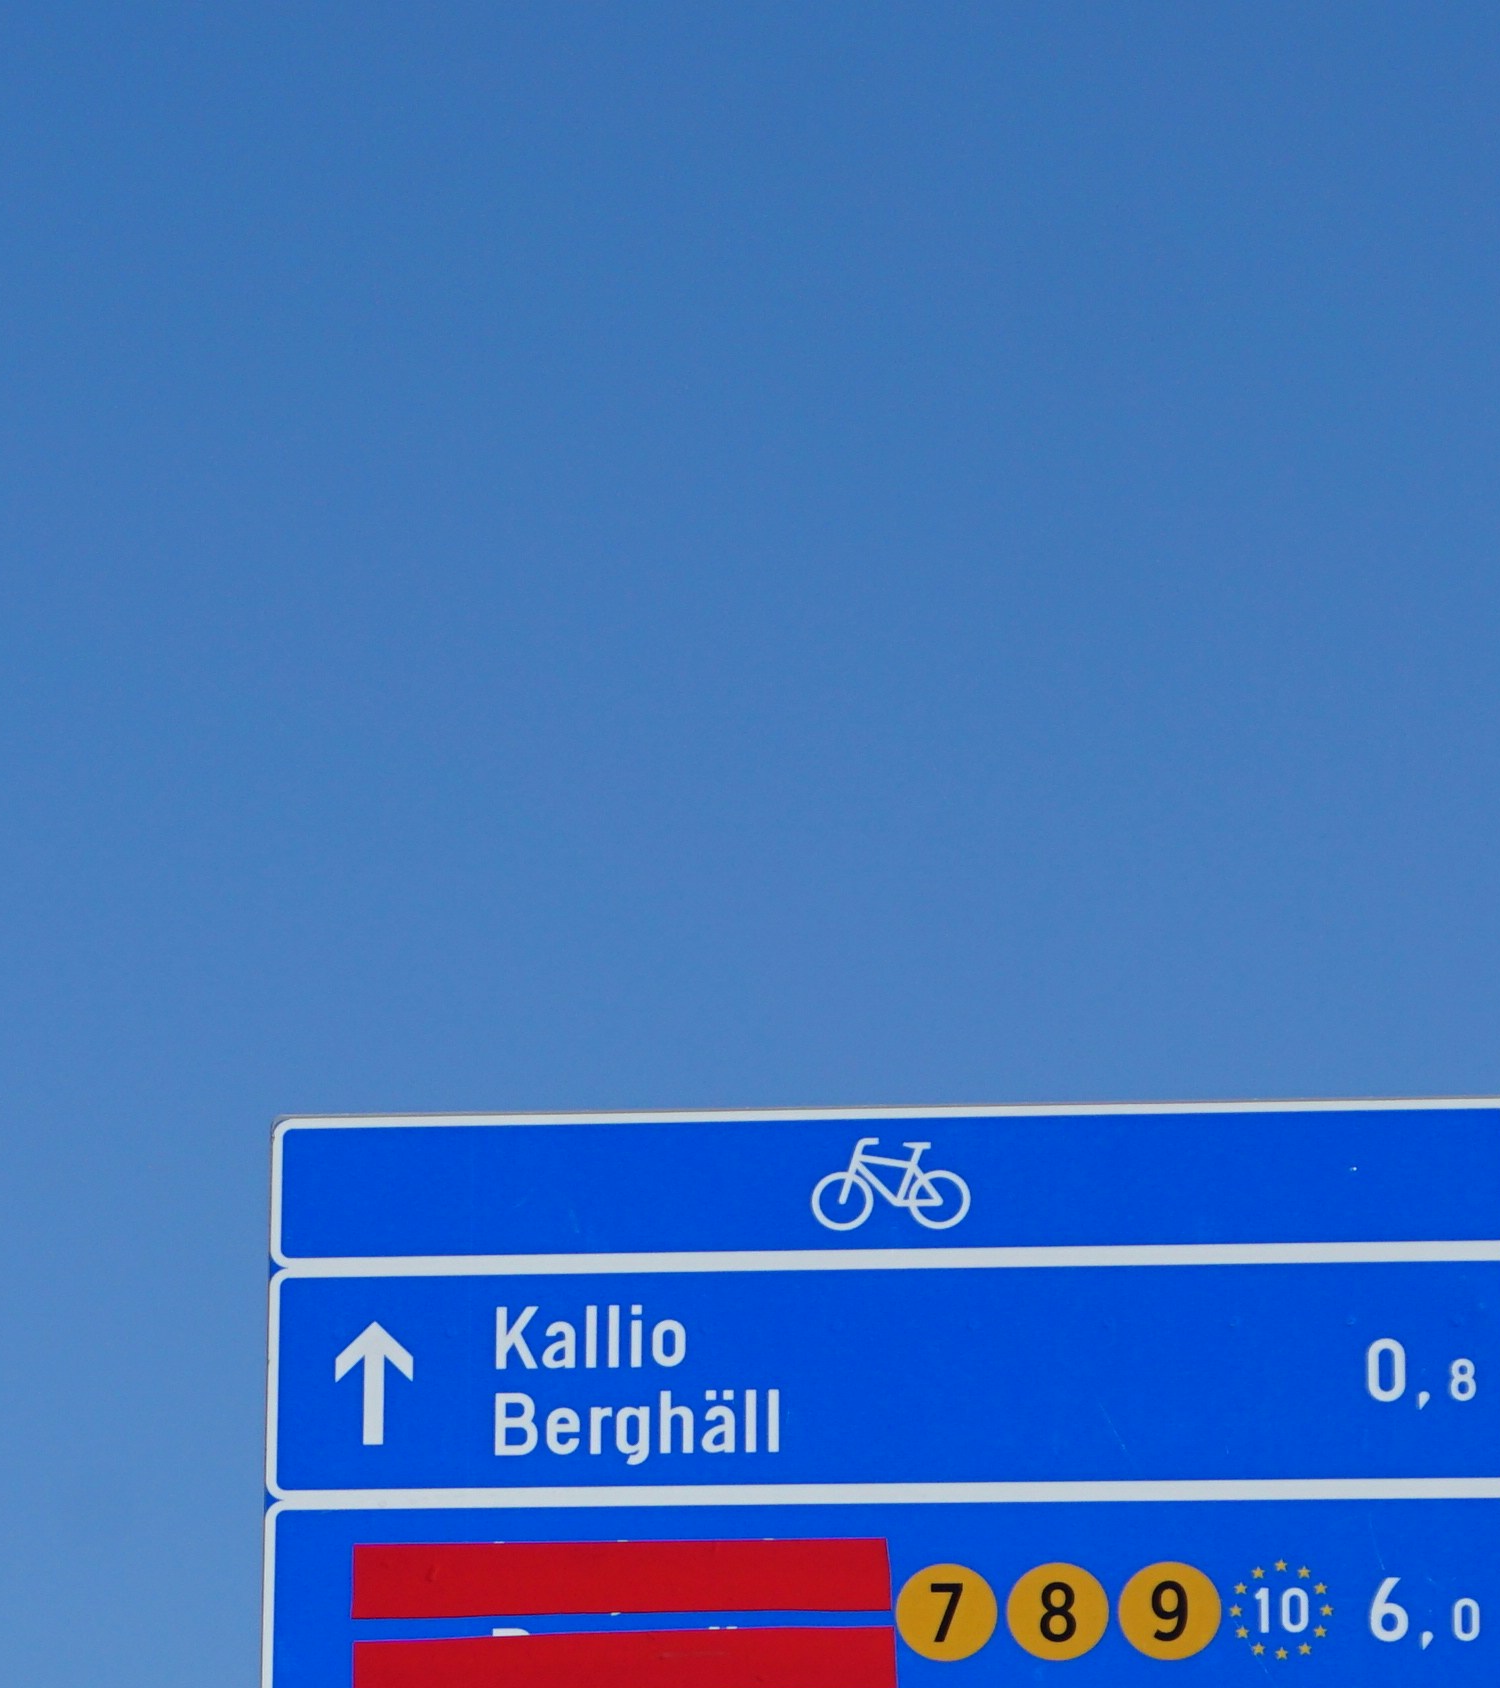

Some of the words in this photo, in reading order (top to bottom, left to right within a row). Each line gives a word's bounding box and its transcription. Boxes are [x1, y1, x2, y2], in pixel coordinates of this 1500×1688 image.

[495, 1304, 687, 1370] Kallio
[1366, 1338, 1477, 1409] 0,8
[494, 1389, 781, 1466] Berghäll
[930, 1582, 963, 1643] 7
[1039, 1581, 1077, 1643] 8
[1151, 1580, 1188, 1642] 9
[1253, 1586, 1310, 1634] 10
[1370, 1577, 1481, 1648] 6,0
